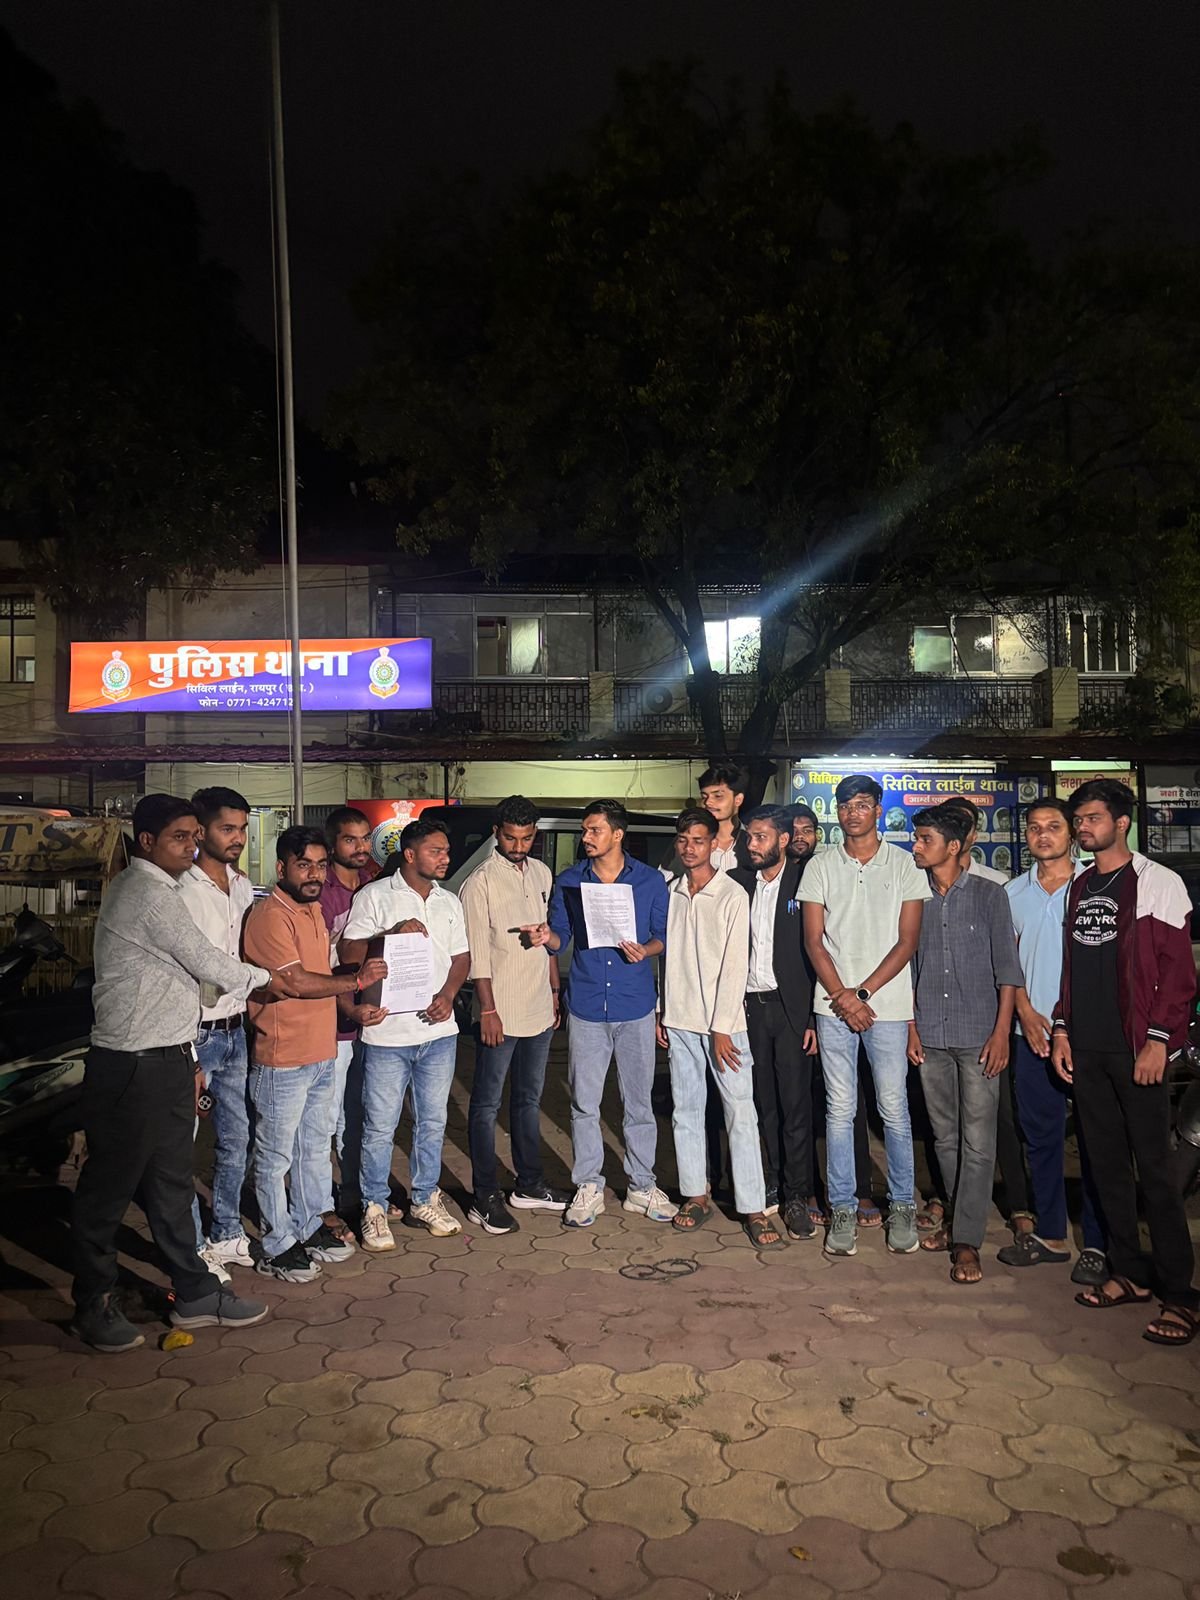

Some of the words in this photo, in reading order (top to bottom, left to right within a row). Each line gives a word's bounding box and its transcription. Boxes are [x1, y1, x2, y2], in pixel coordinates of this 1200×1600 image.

[148, 646, 258, 688] पुलिस
[265, 651, 352, 677] थाना
[186, 683, 217, 694] सिविल
[218, 681, 248, 695] लाईन,
[249, 683, 277, 695] रायपुर
[882, 774, 931, 792] सिविल
[936, 775, 976, 794] लाईन
[980, 778, 1014, 792] थाना
